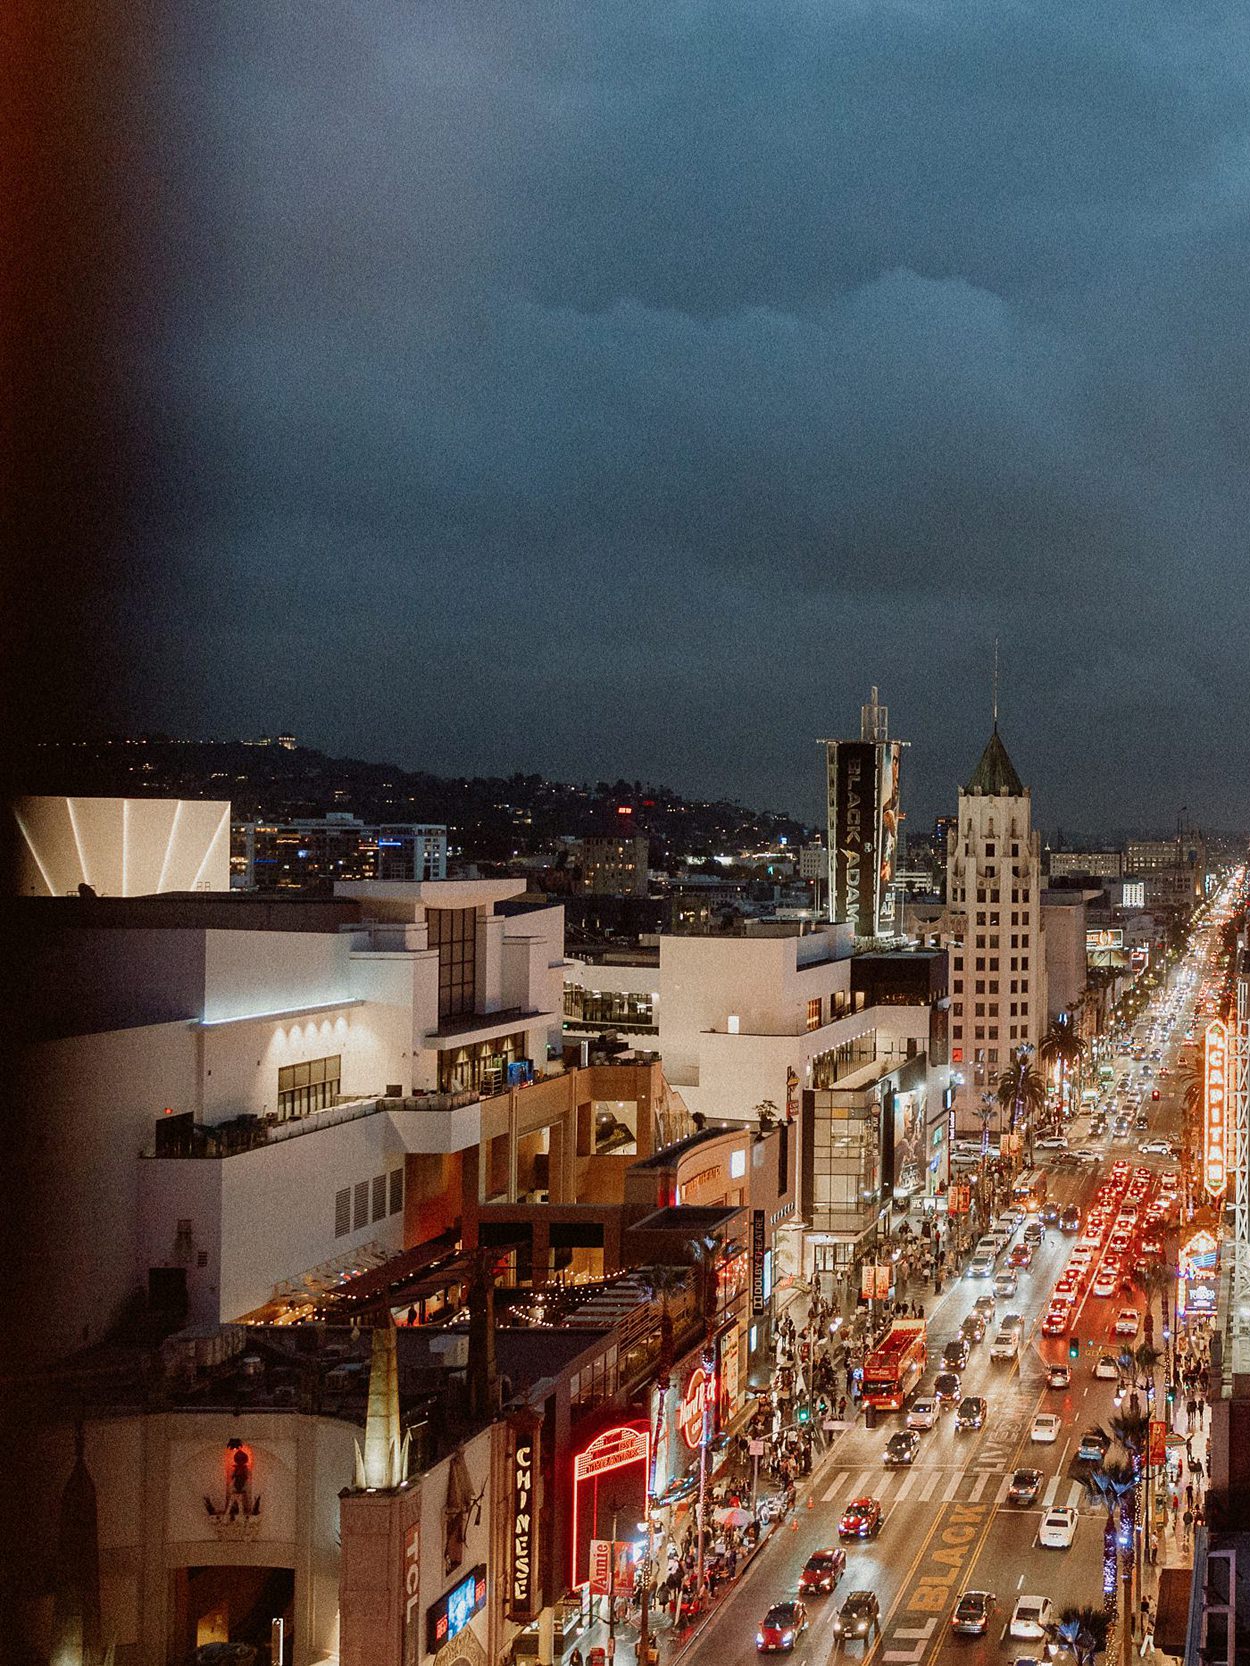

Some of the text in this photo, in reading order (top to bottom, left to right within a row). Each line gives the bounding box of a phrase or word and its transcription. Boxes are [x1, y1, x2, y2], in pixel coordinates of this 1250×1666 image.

[840, 760, 861, 922] BLACK ADAM
[1208, 1051, 1224, 1180] CAPITAN
[754, 1217, 764, 1294] DOLBY THEATRE
[514, 1446, 531, 1600] CHINESE
[596, 1544, 608, 1590] Annie
[907, 1504, 988, 1611] BLACK
[406, 1530, 419, 1625] TCL
[881, 1617, 939, 1666] LL
